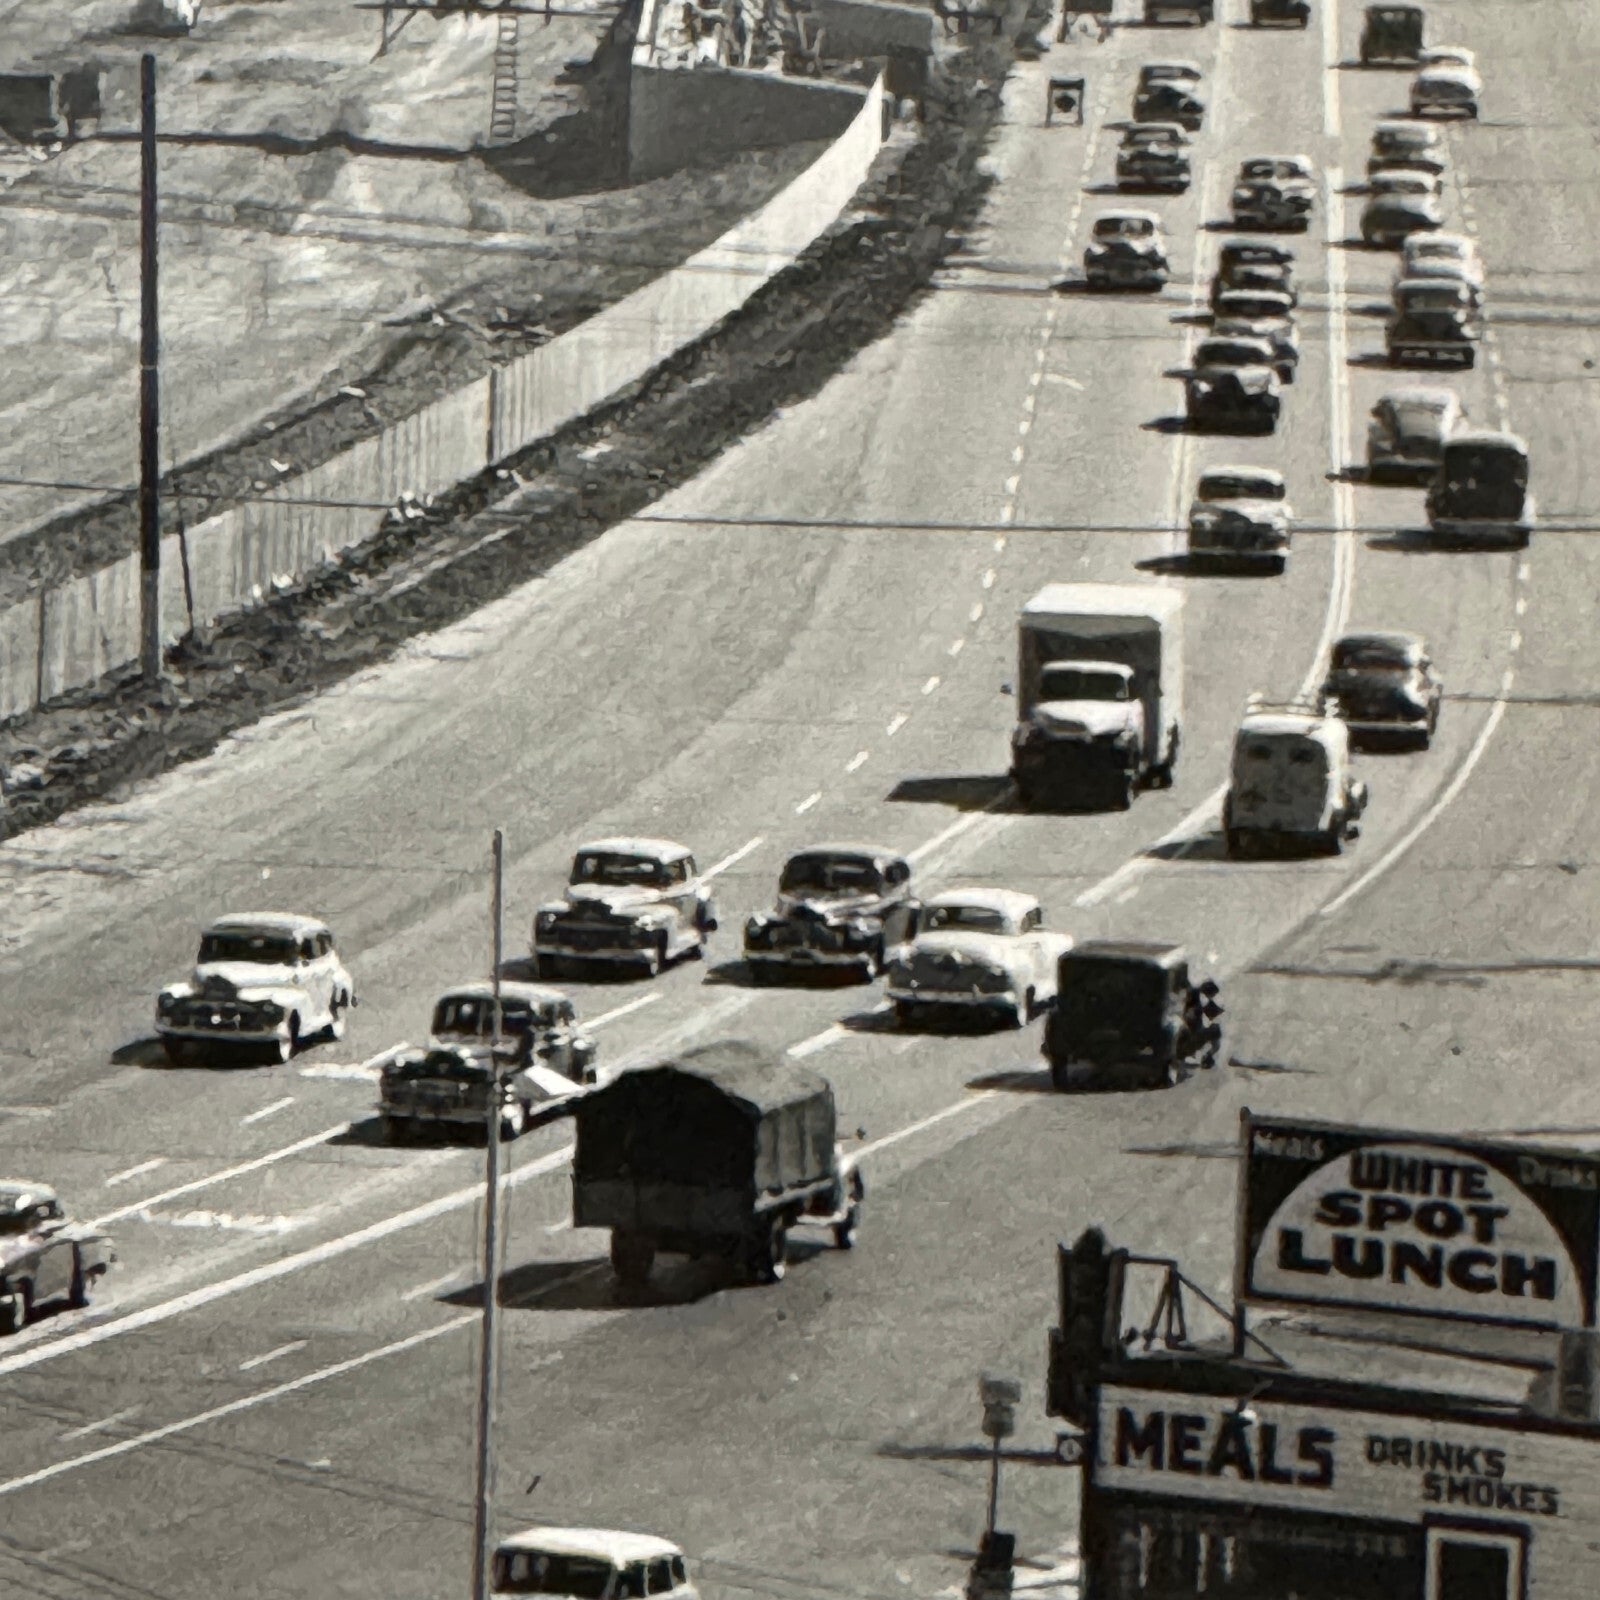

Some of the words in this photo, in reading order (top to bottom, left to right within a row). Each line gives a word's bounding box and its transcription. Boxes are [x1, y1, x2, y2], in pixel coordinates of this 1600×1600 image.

[1350, 1151, 1493, 1199] WHITE
[1315, 1192, 1508, 1243] SPOT
[1277, 1228, 1556, 1300] LUNCH
[1115, 1407, 1335, 1489] MEALS
[1366, 1435, 1506, 1478] DRINKS
[1421, 1474, 1559, 1515] SMOKES
